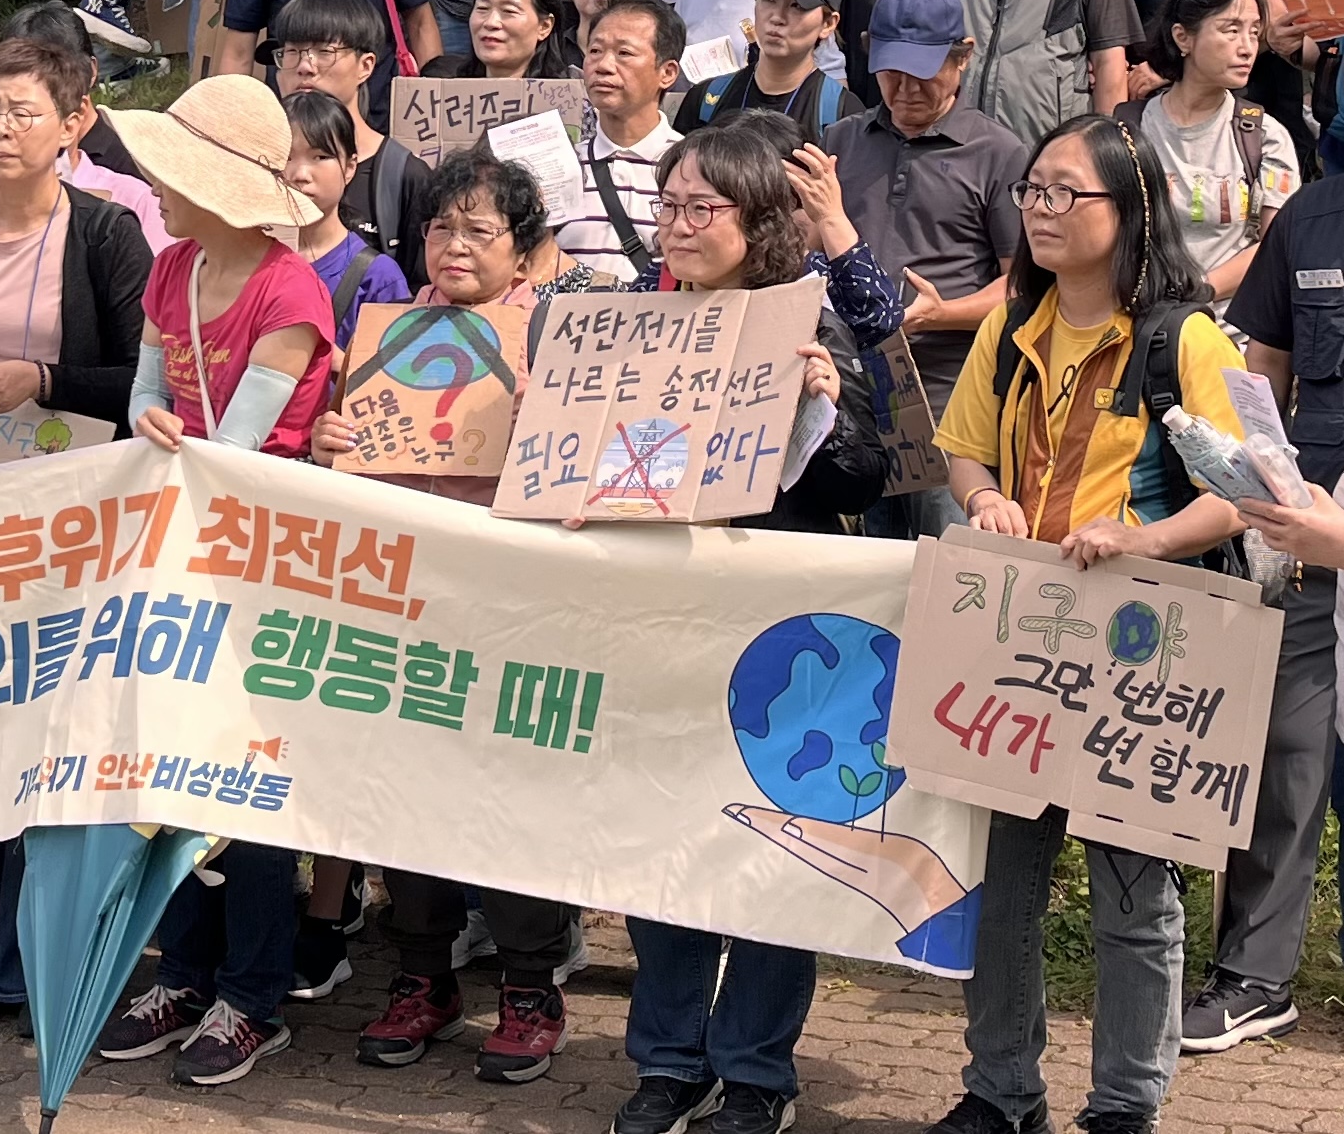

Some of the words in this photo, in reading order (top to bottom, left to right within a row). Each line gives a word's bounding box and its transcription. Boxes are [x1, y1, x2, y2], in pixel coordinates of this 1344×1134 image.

[553, 306, 723, 355] 석탄전기를
[350, 388, 400, 419] 다음
[544, 360, 641, 409] 나르는
[659, 362, 780, 415] 송전선로
[516, 432, 590, 501] 필요
[701, 423, 780, 494] 없다
[953, 565, 1188, 683] 지구야
[241, 607, 479, 734] 행동할
[493, 659, 607, 755] 때!
[1113, 669, 1227, 740] 변해
[933, 681, 1056, 774] 내가
